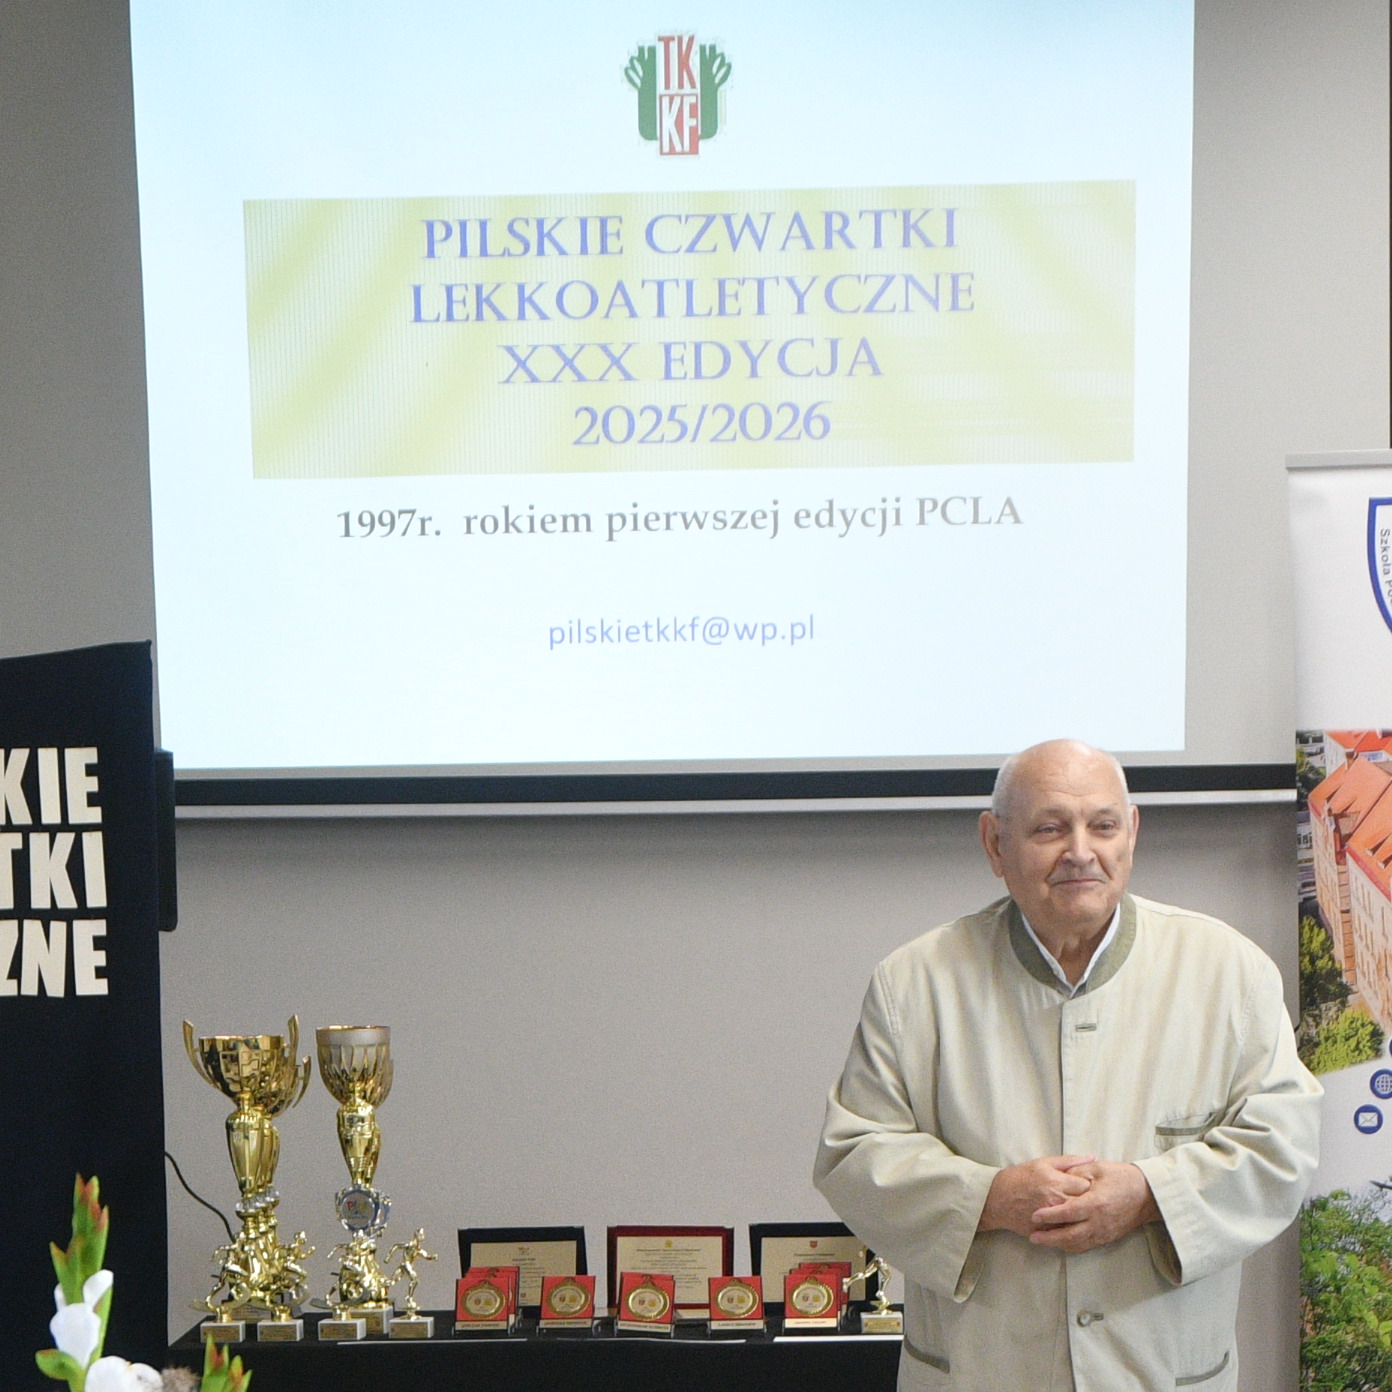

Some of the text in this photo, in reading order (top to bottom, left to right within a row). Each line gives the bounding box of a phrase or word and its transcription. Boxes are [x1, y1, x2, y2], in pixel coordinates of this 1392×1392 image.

[658, 34, 697, 90] TK
[662, 95, 697, 153] KF
[421, 208, 960, 259] PILSKIE CZWARTKI
[410, 271, 976, 323] LEKKOATLETYCZNE
[498, 336, 885, 384] XXX EDYCJA
[572, 400, 832, 446] 2025/2026
[337, 495, 1024, 542] 1997r. rokiem pierwszej edycji PCLA
[1380, 528, 1391, 575] Szkoła
[548, 614, 815, 651] pilskietkkf@wp.pl
